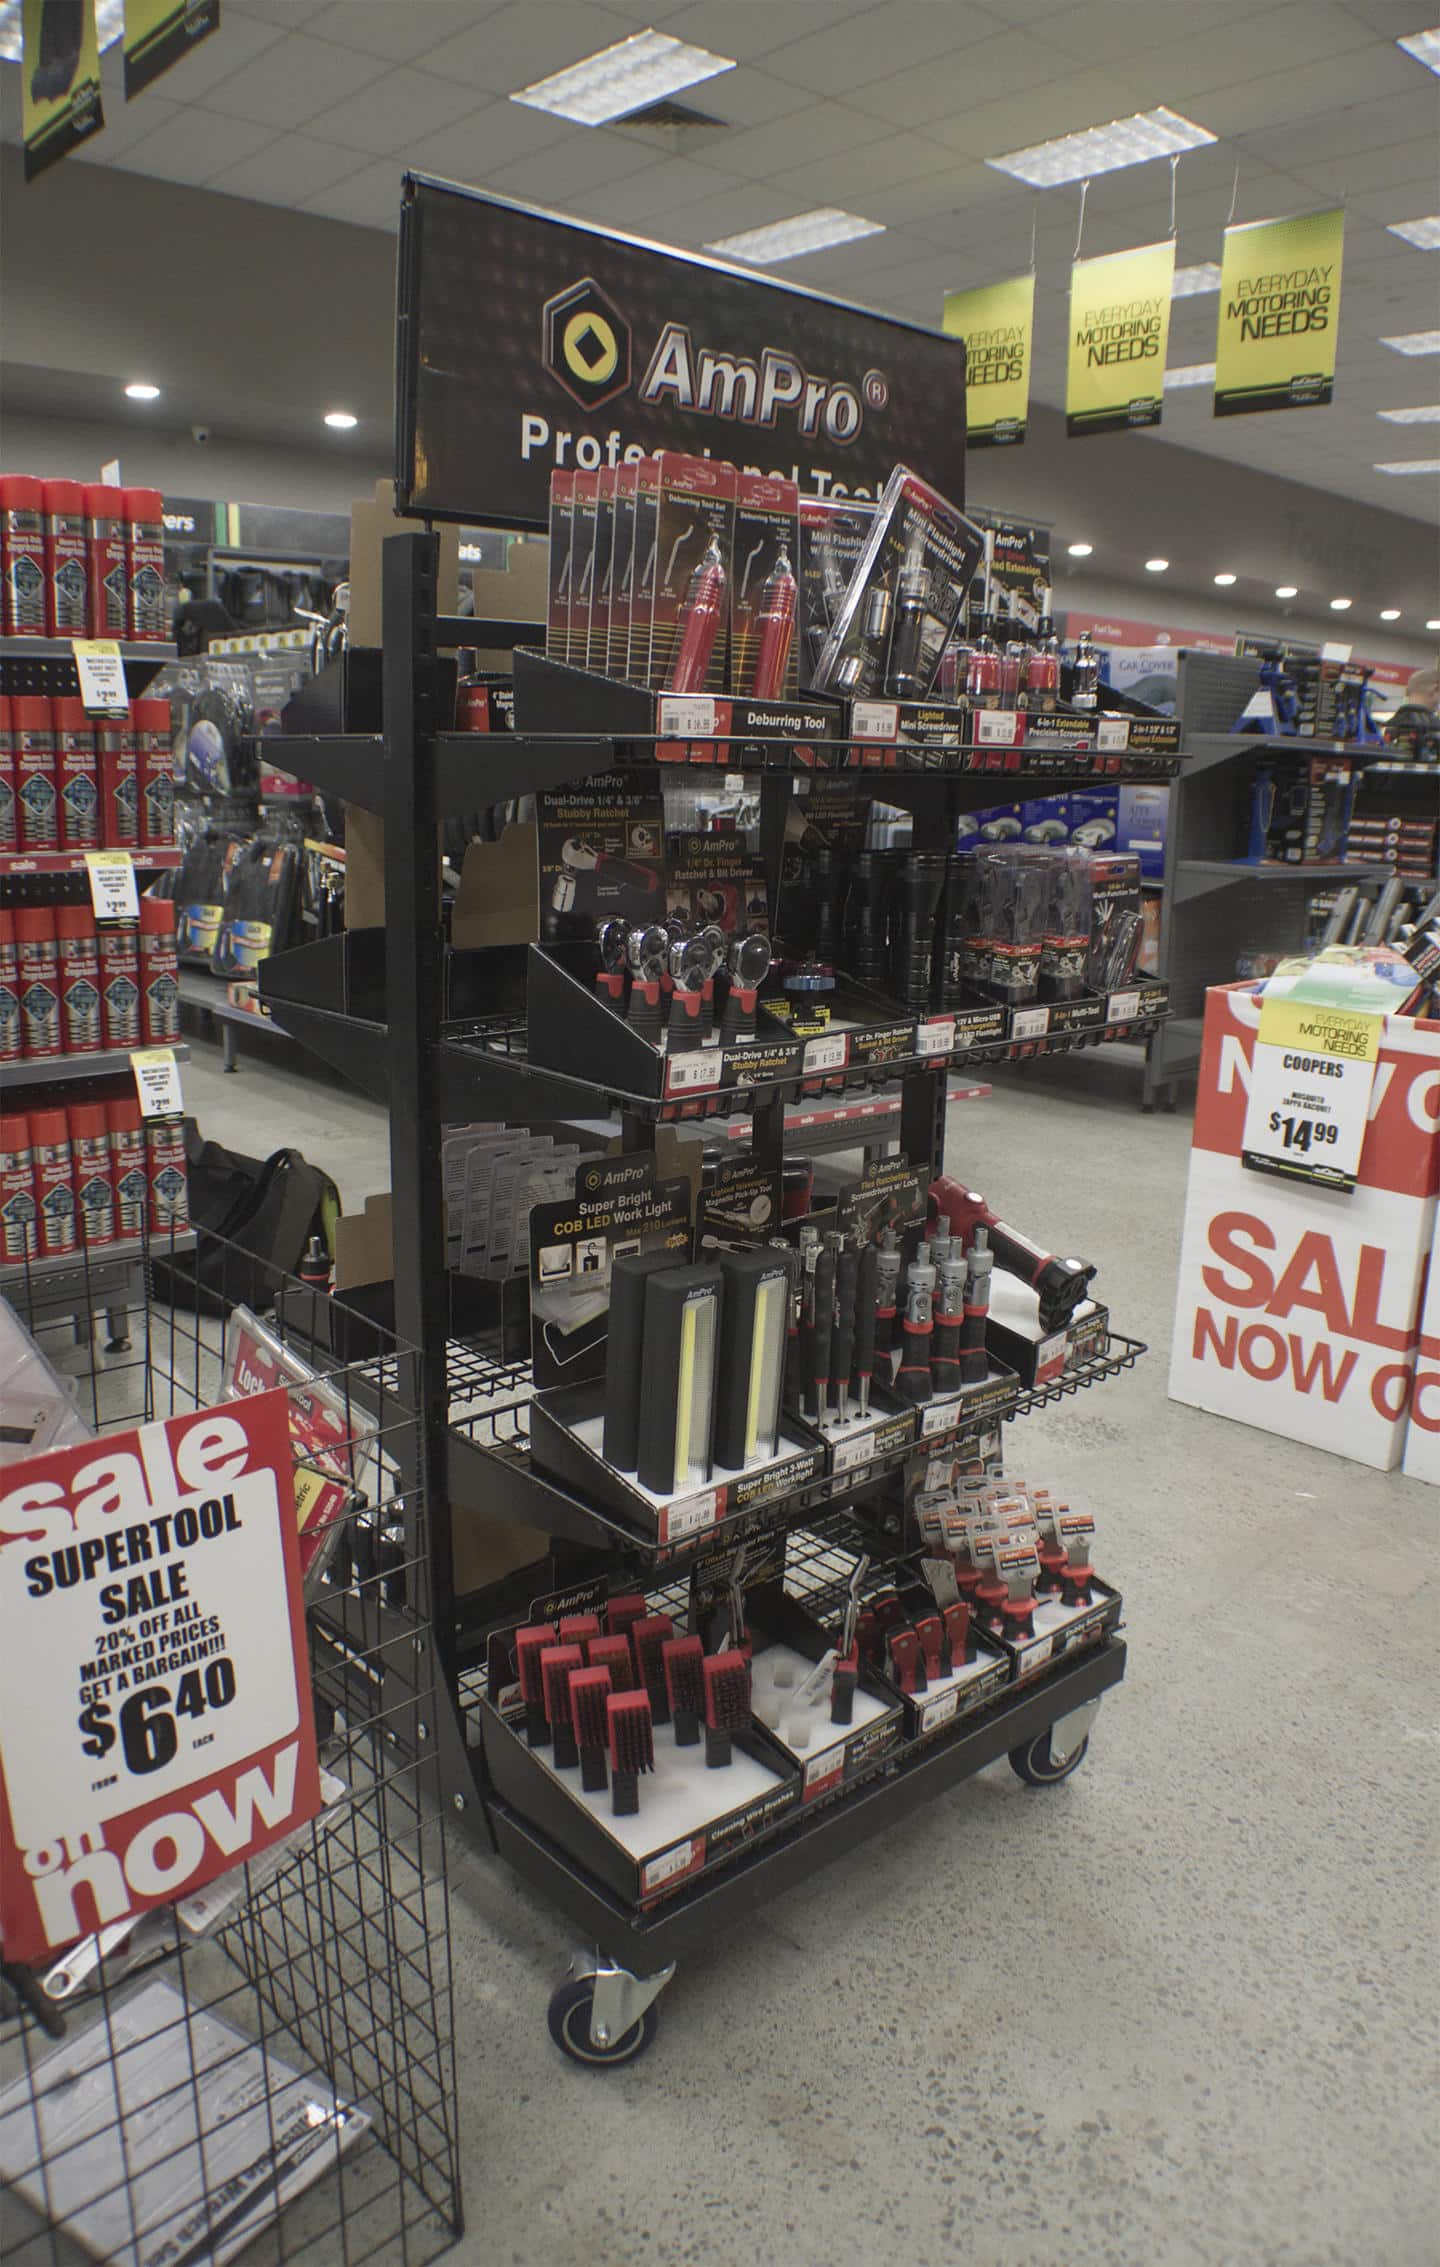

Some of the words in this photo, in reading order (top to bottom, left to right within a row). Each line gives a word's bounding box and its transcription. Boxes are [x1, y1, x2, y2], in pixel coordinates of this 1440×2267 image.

[1237, 264, 1334, 298] EVERYDAY
[1084, 296, 1165, 328] EVERYDAY
[1227, 286, 1331, 320] MOTORING
[1076, 316, 1161, 347] MOTORING
[1240, 307, 1329, 343] NEEDS
[1087, 334, 1159, 368] NEEDS
[747, 711, 801, 730] Deburring
[803, 715, 826, 729] Tool
[586, 776, 624, 788] AmPro
[702, 840, 735, 851] AmPro
[10, 859, 37, 870] sale
[1299, 1023, 1369, 1045] MOTORING
[1316, 1013, 1370, 1031] EVERYDAY
[723, 1051, 762, 1064] Dual-Drive
[1323, 1040, 1367, 1057] NEEDS
[732, 1059, 758, 1072] Stubby
[759, 1057, 788, 1070] Ratchet
[1283, 1054, 1344, 1079] COOPERS
[603, 1168, 644, 1186] AmPro
[579, 1199, 615, 1216] Super
[618, 1189, 652, 1207] Bright
[554, 1217, 583, 1236] COB
[586, 1214, 611, 1231] LED
[614, 1208, 643, 1224] Work
[645, 1200, 672, 1217] Light
[761, 1268, 785, 1281] AmPro
[687, 1287, 714, 1299] AmPro
[1191, 1306, 1360, 1404] NOW
[0, 1416, 249, 1545] sale
[737, 1478, 762, 1494] Super
[763, 1465, 789, 1484] Bright
[25, 1494, 242, 1598] SUPERTOOL
[99, 1561, 190, 1625] SALE
[557, 1591, 594, 1610] AmPro
[96, 1623, 136, 1656] 20%
[139, 1613, 170, 1639] OFF
[172, 1601, 202, 1628] ALL
[79, 1642, 155, 1684] MARKED
[158, 1615, 221, 1657] PRICES
[79, 1675, 114, 1706] GET
[116, 1671, 130, 1691] A
[132, 1634, 226, 1686] BARGAIN!!!
[192, 1732, 215, 1750] EACH
[32, 1741, 299, 1948] now
